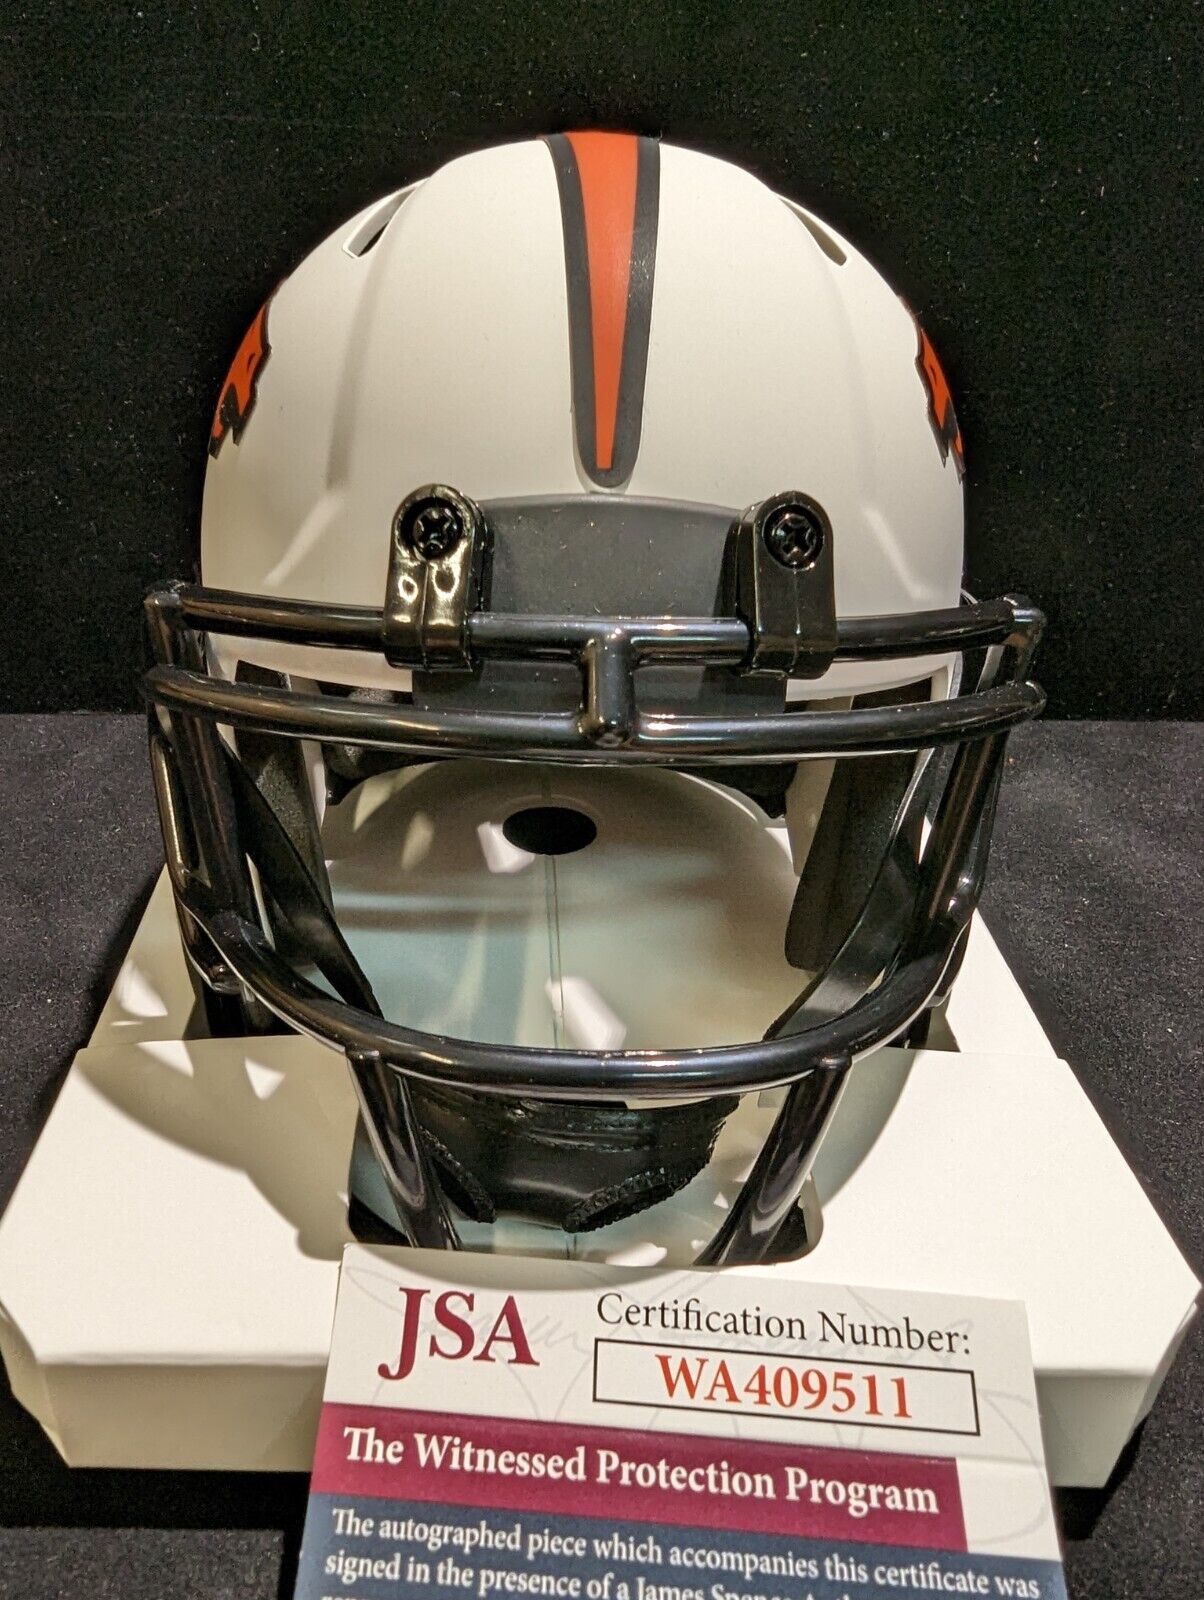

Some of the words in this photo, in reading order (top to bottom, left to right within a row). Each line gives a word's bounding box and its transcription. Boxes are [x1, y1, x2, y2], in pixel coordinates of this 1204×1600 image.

[377, 1286, 540, 1380] JSA
[597, 1293, 807, 1342] Certification
[818, 1311, 971, 1355] Number:
[655, 1354, 912, 1419] WA409511
[344, 1427, 404, 1464] The
[414, 1433, 586, 1482] Witnessed
[596, 1450, 776, 1500] Protection
[786, 1466, 940, 1518] Program
[324, 1550, 401, 1585] signed
[407, 1556, 430, 1584] in
[436, 1557, 474, 1588] the
[478, 1569, 582, 1597] presence
[586, 1572, 615, 1600] of
[616, 1582, 630, 1600] a
[332, 1508, 374, 1536] The
[378, 1519, 522, 1554] autographed
[527, 1528, 587, 1560] piece
[592, 1532, 663, 1565] which
[669, 1546, 819, 1581] accompanies
[823, 1554, 869, 1584] this
[874, 1561, 990, 1595] certificate
[995, 1575, 1041, 1600] was
